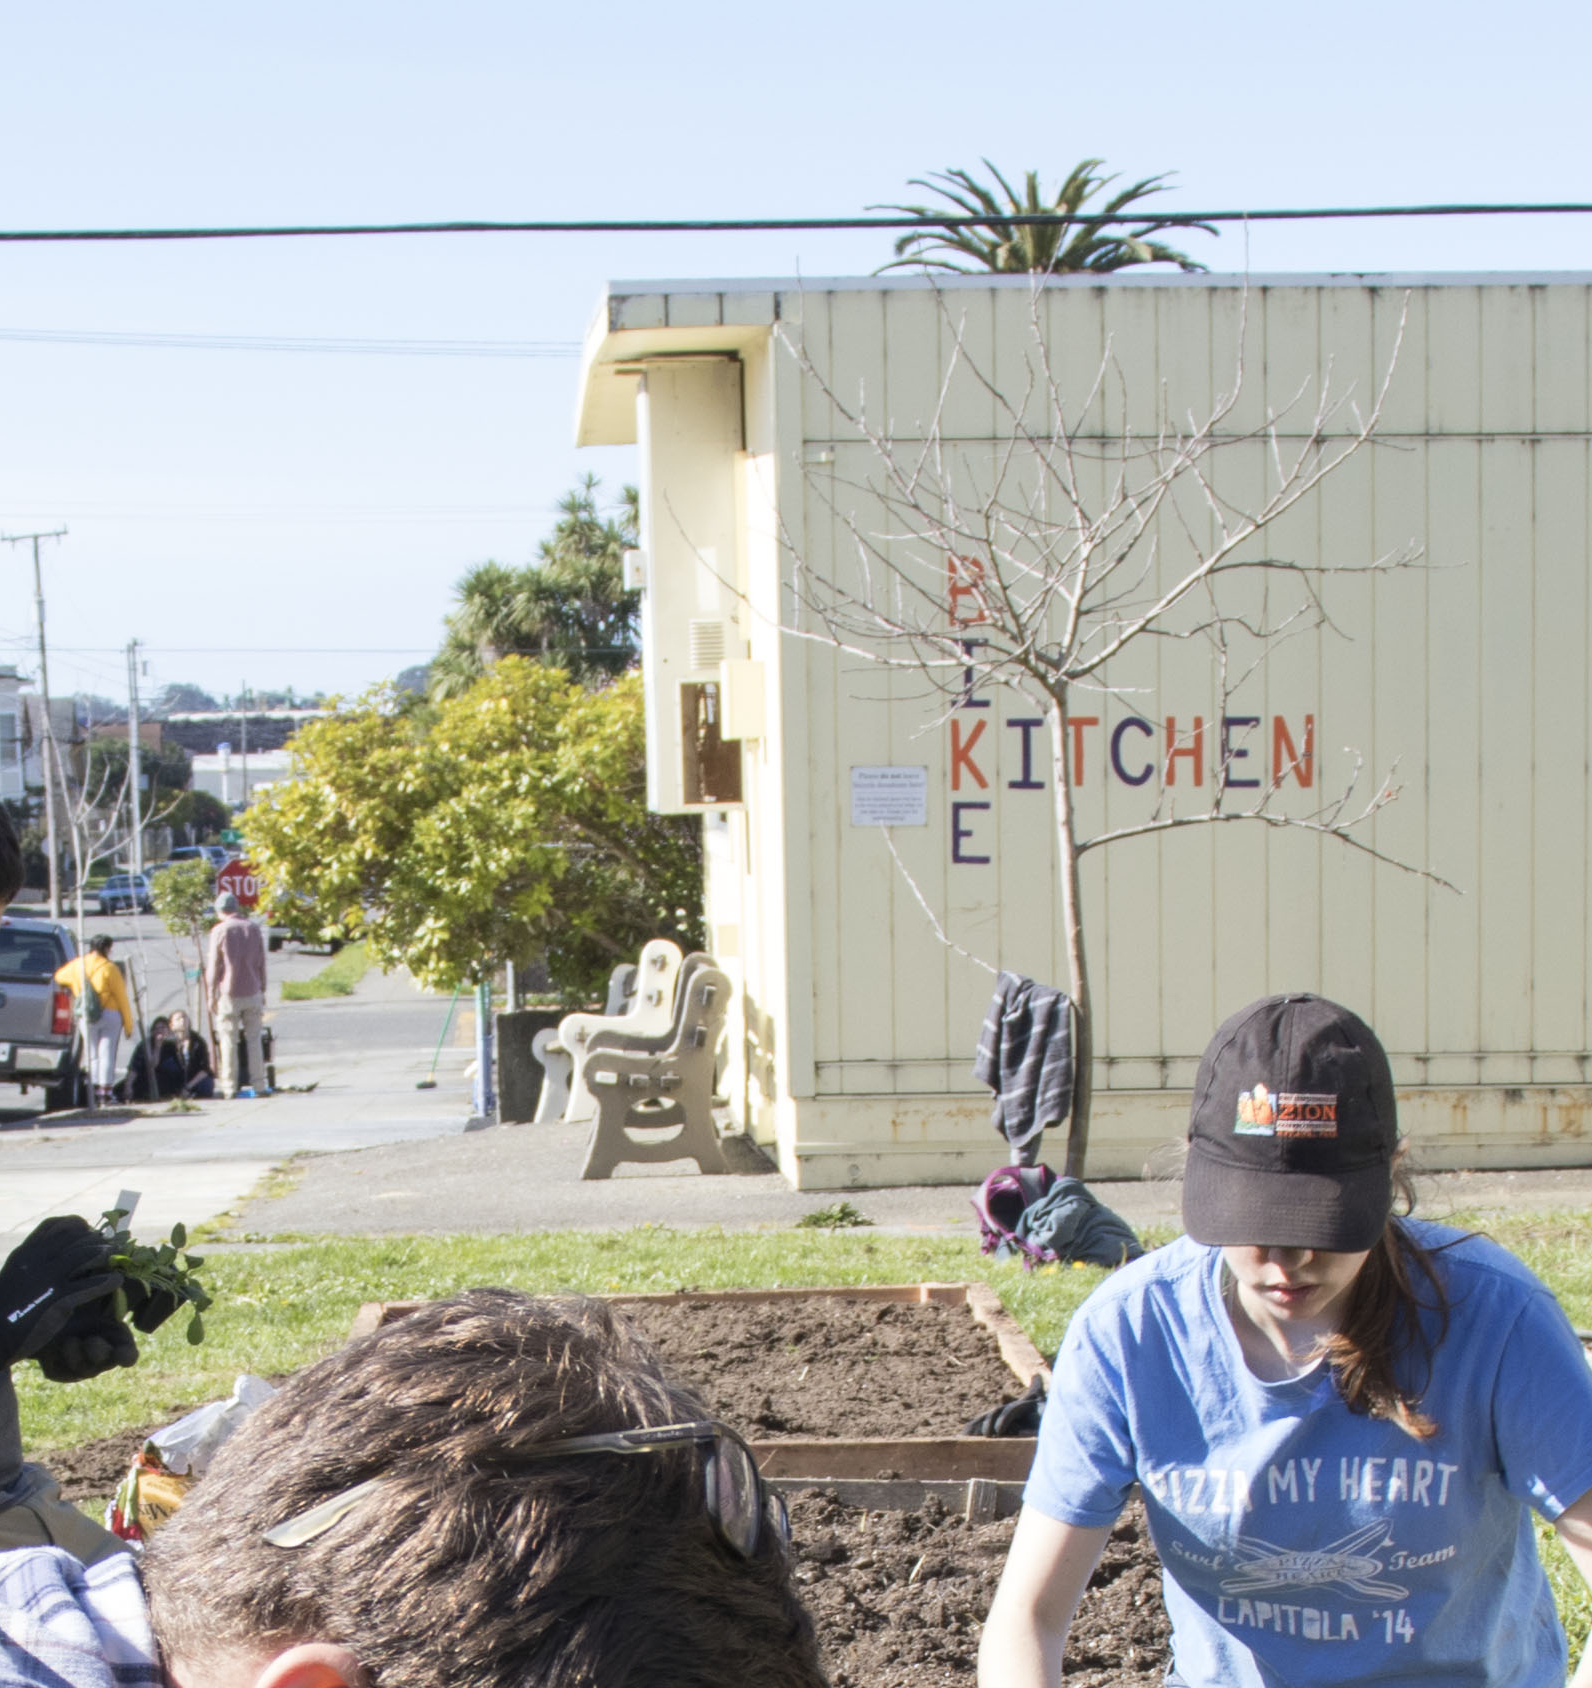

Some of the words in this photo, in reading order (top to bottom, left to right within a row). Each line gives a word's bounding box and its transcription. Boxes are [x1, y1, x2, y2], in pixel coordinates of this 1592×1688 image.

[948, 555, 992, 864] BIKE
[950, 714, 1316, 791] KITCHEN
[220, 875, 268, 897] STOP
[1278, 1104, 1337, 1120] ZION
[1146, 1466, 1253, 1515] PIZZA
[1268, 1458, 1322, 1505] MY
[1339, 1456, 1459, 1507] HEART
[1388, 1544, 1457, 1571] Team
[1217, 1595, 1360, 1641] CAPITOLA
[1372, 1608, 1416, 1644] '14
